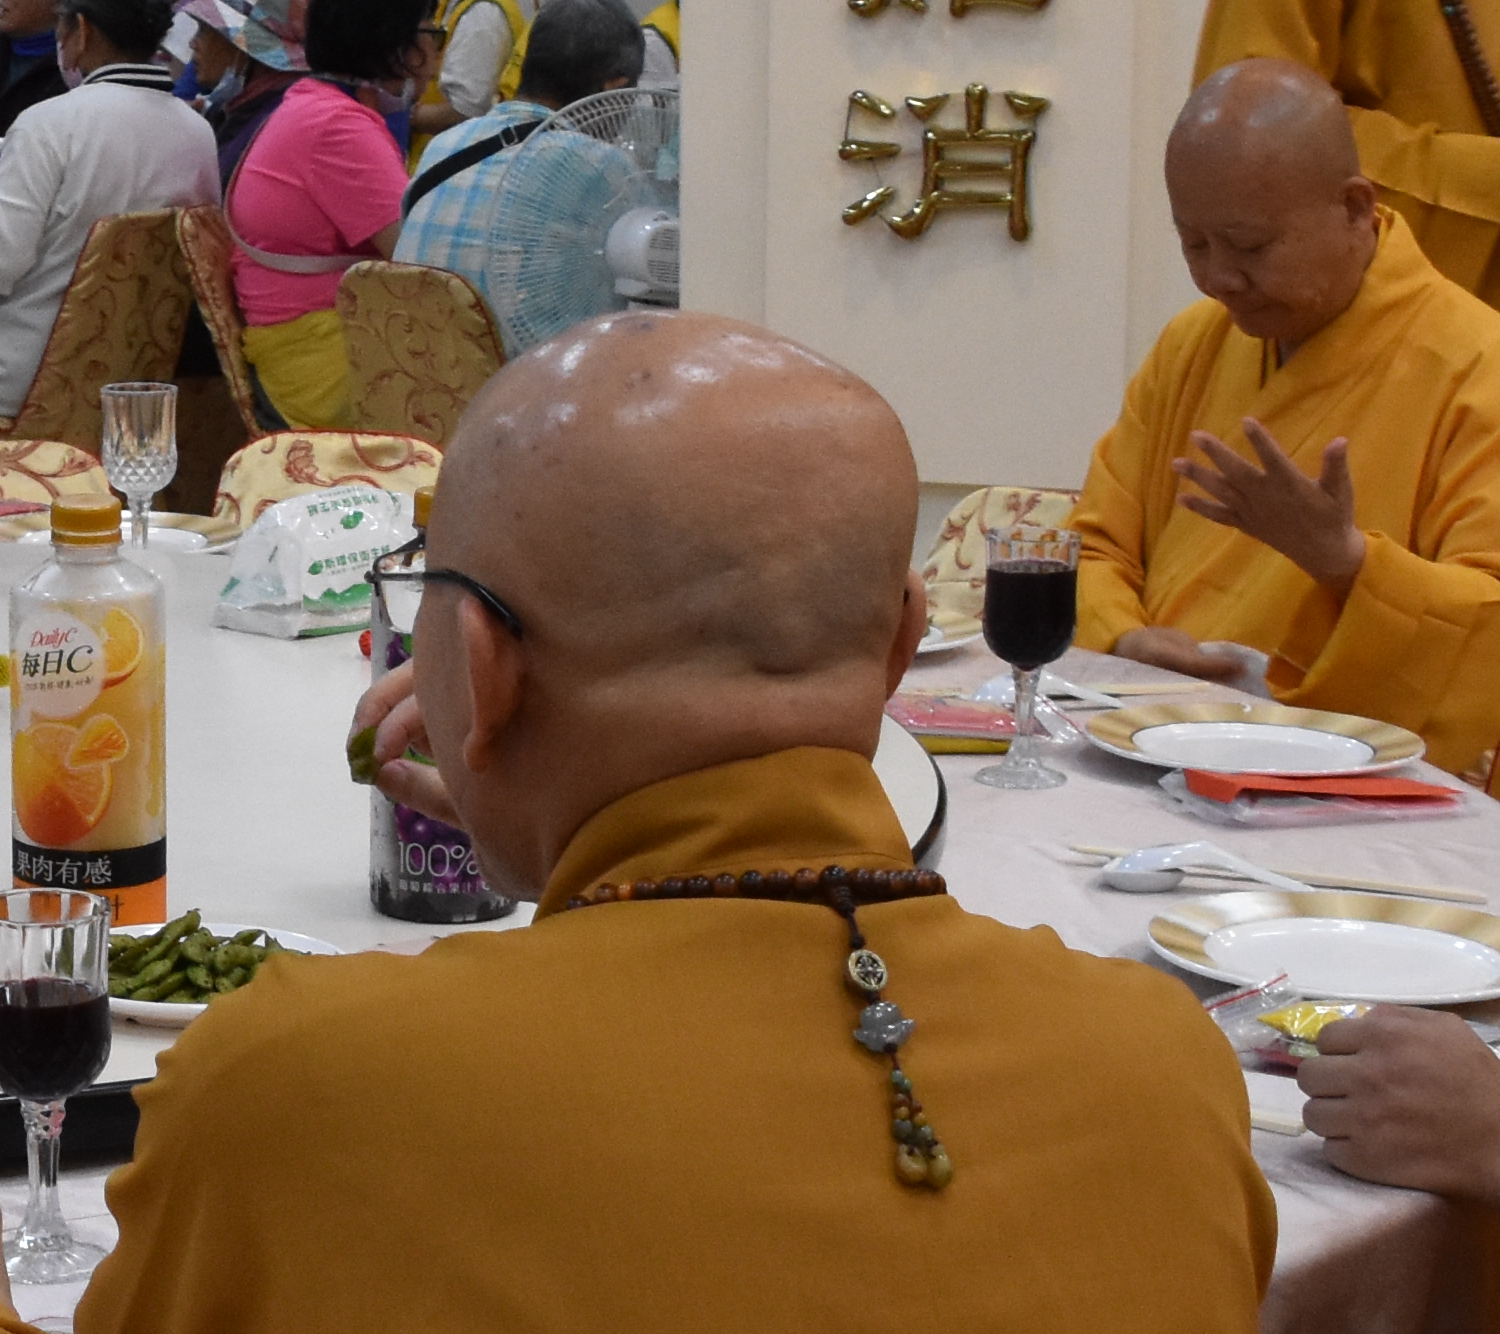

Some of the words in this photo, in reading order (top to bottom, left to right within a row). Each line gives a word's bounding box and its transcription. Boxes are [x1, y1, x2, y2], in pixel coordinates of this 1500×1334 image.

[21, 644, 94, 678] 每日C
[15, 849, 113, 885] 果肉有感
[398, 840, 479, 877] 100%
